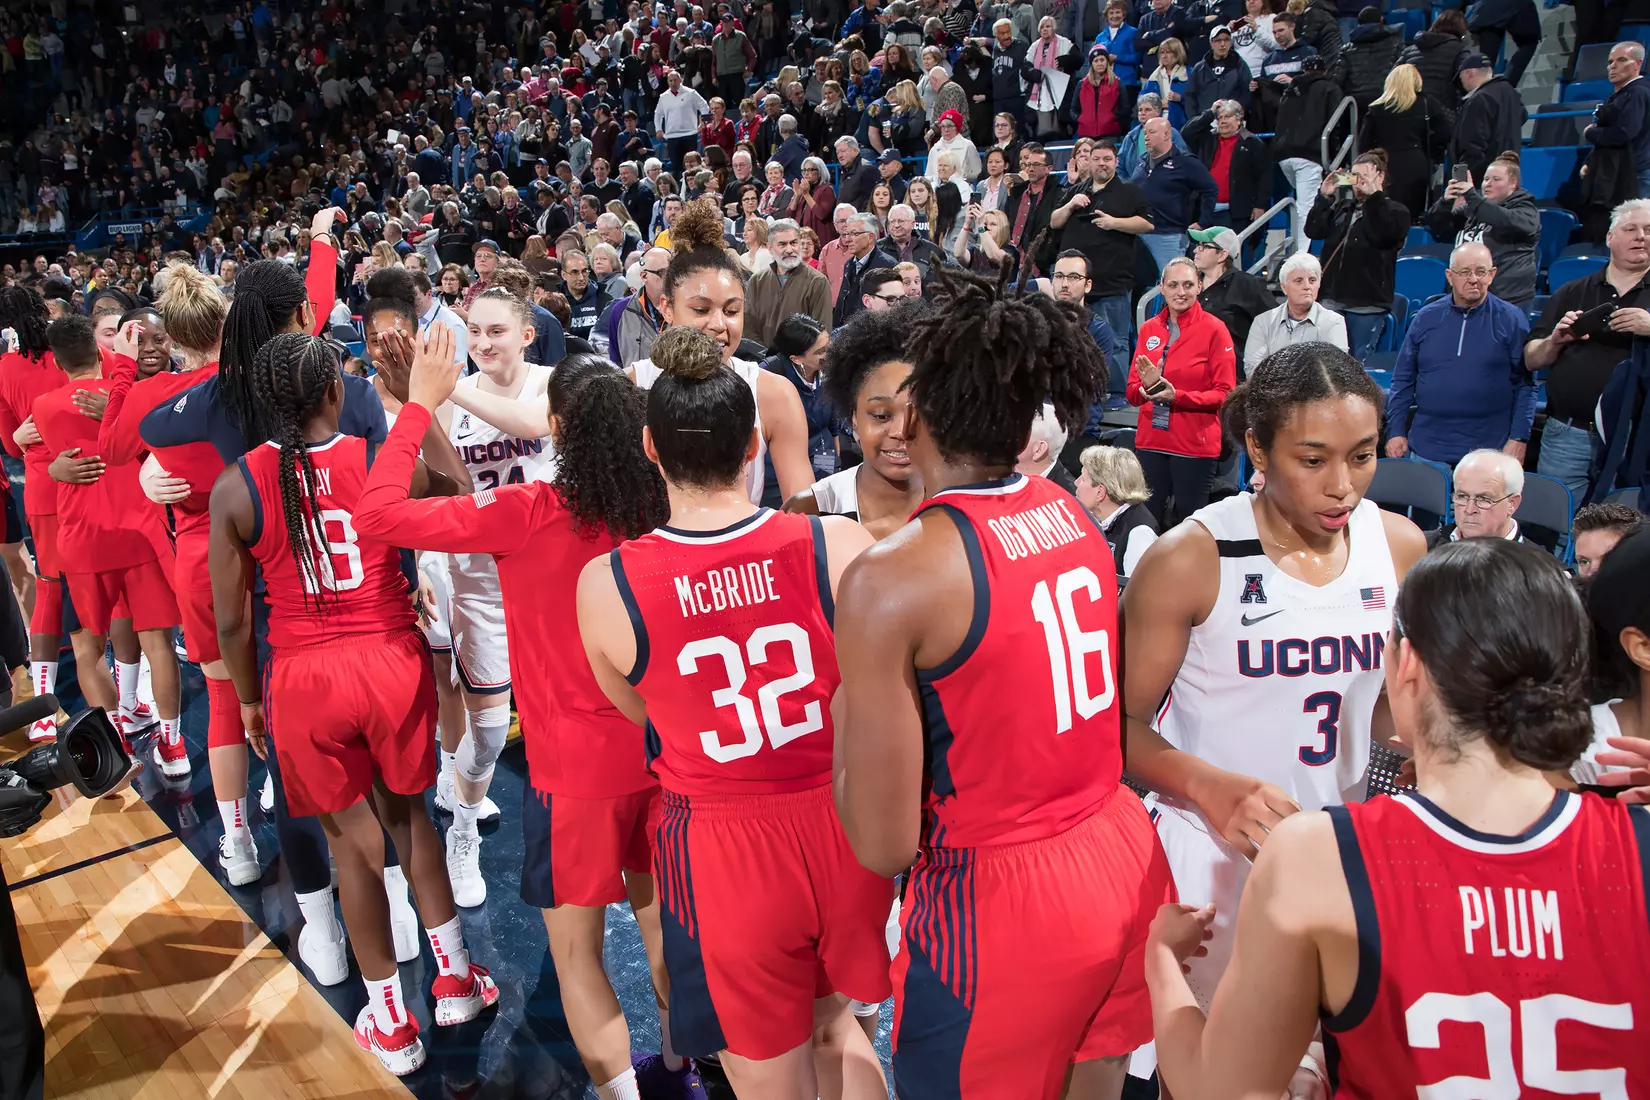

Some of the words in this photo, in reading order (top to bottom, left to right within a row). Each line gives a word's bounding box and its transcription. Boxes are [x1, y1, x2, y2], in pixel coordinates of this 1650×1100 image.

[456, 437, 543, 465] UCONN
[988, 498, 1086, 562] OGWUMIKE
[673, 559, 780, 618] McBRIDE
[1031, 565, 1115, 735] 16
[1237, 630, 1391, 678] UCONN
[676, 622, 824, 764] 32
[1298, 691, 1343, 767] 3
[1458, 885, 1564, 960] PLUM
[411, 1058, 418, 1067] 8
[1405, 991, 1634, 1100] 25
